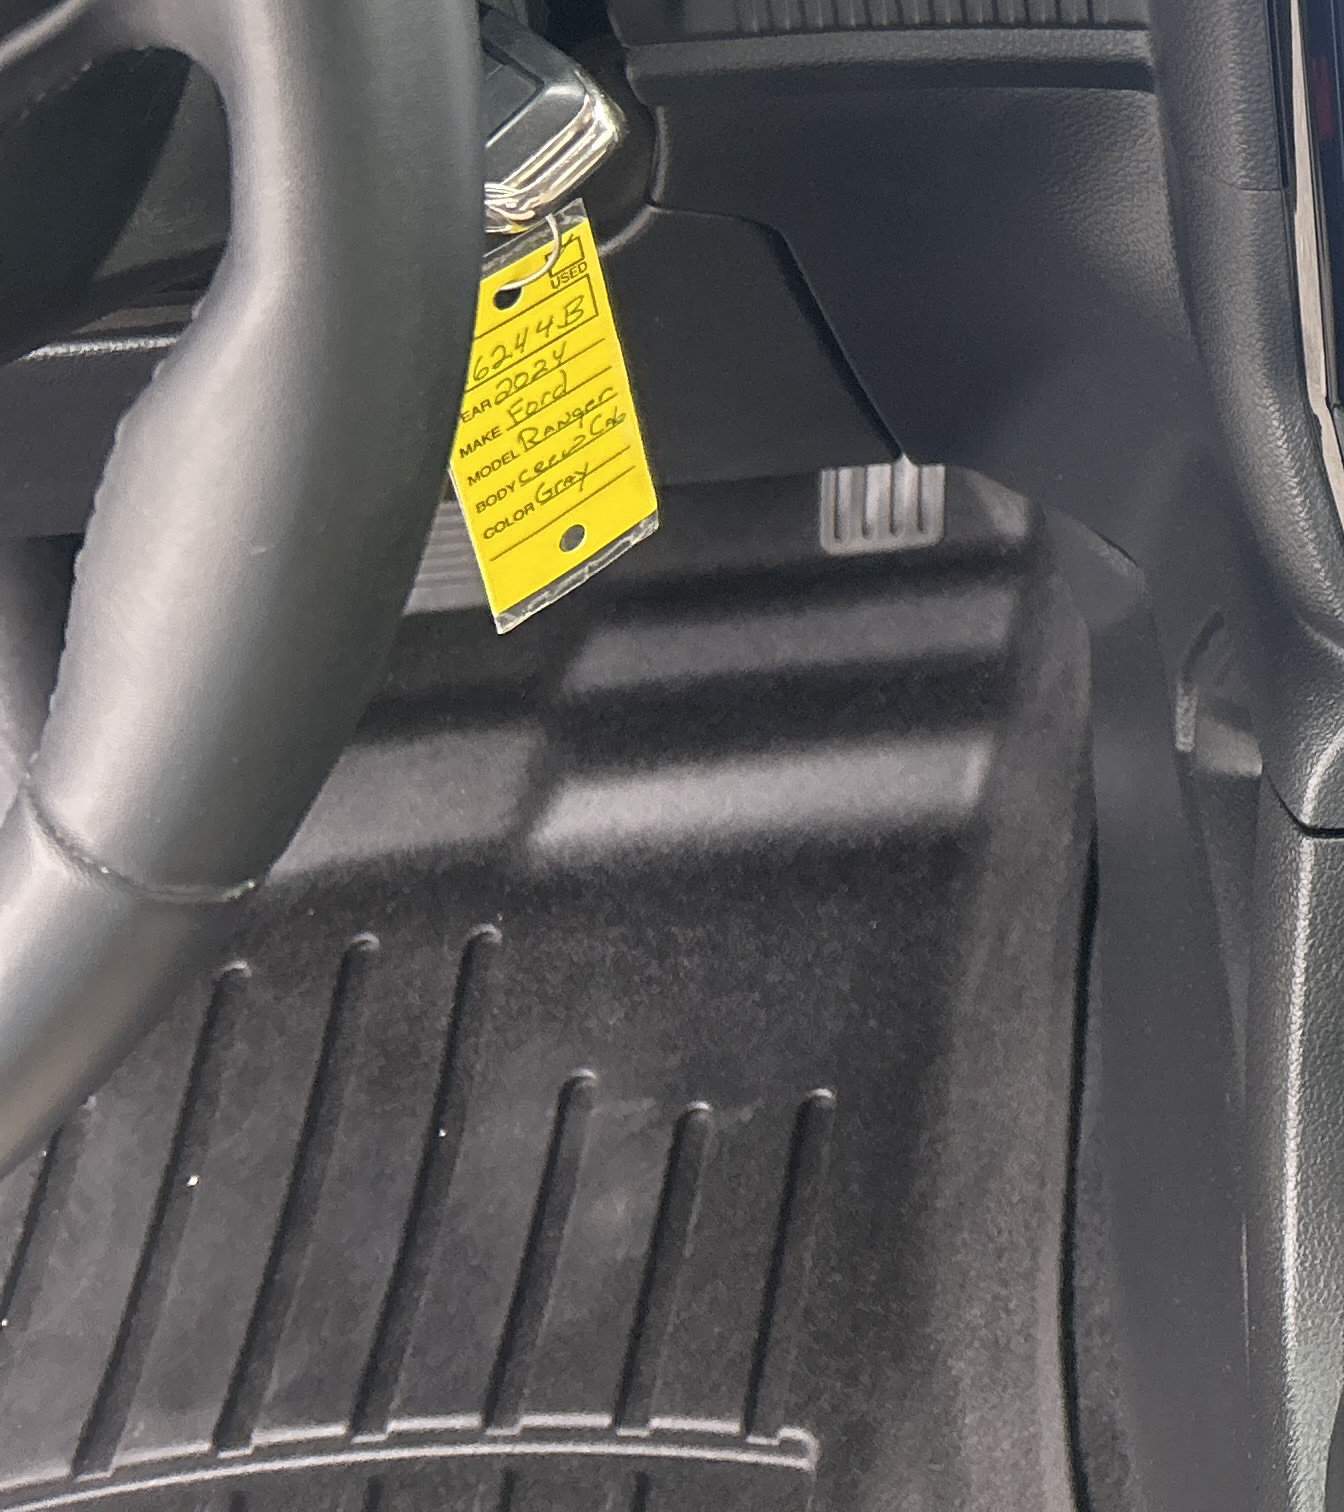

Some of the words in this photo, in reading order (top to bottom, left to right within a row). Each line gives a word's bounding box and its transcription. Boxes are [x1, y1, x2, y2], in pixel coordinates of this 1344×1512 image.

[550, 261, 588, 289] USED
[494, 340, 567, 406] 2024
[460, 399, 492, 424] EAR
[506, 369, 568, 426] Ford
[459, 425, 502, 459] MAKE
[467, 449, 521, 487] MODEL
[475, 480, 517, 514] BODY
[483, 501, 536, 540] COLOR
